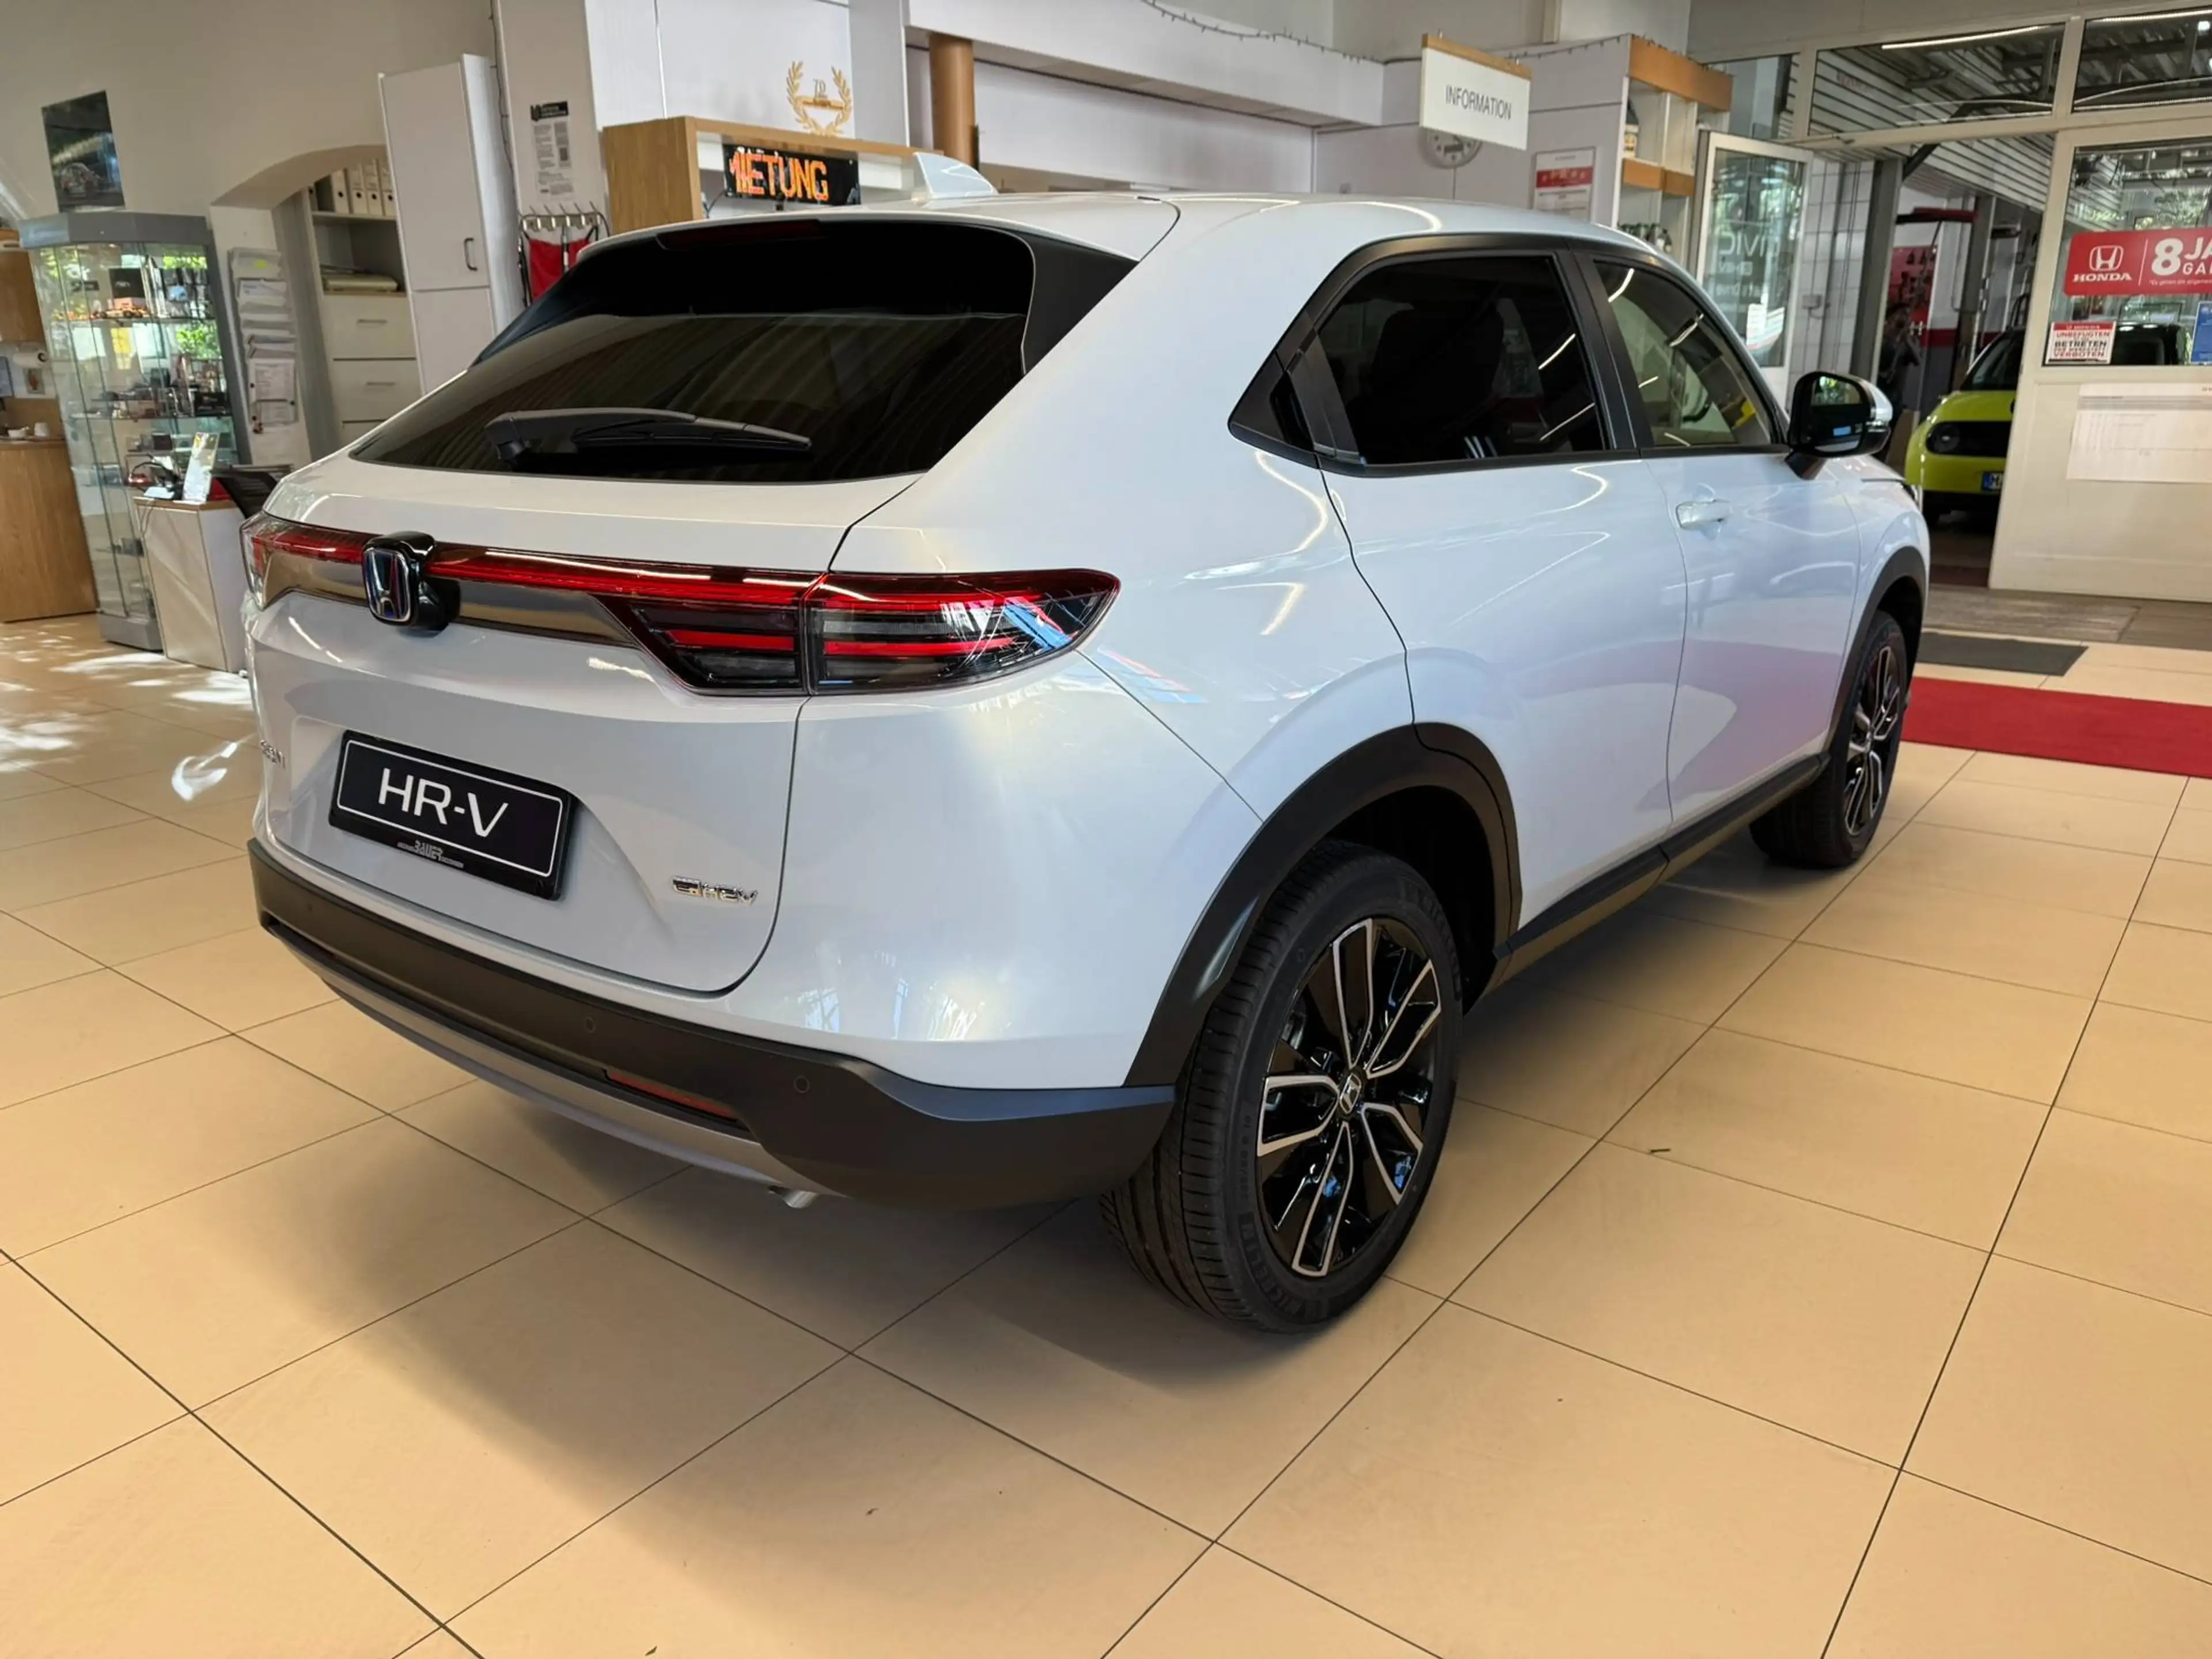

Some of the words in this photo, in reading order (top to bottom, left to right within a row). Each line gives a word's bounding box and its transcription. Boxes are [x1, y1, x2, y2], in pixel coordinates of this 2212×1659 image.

[1445, 84, 1512, 120] INFORMATION
[2151, 237, 2183, 276] 8
[2182, 262, 2212, 275] GA
[2073, 272, 2133, 283] HONDA
[378, 768, 509, 837] HR-V
